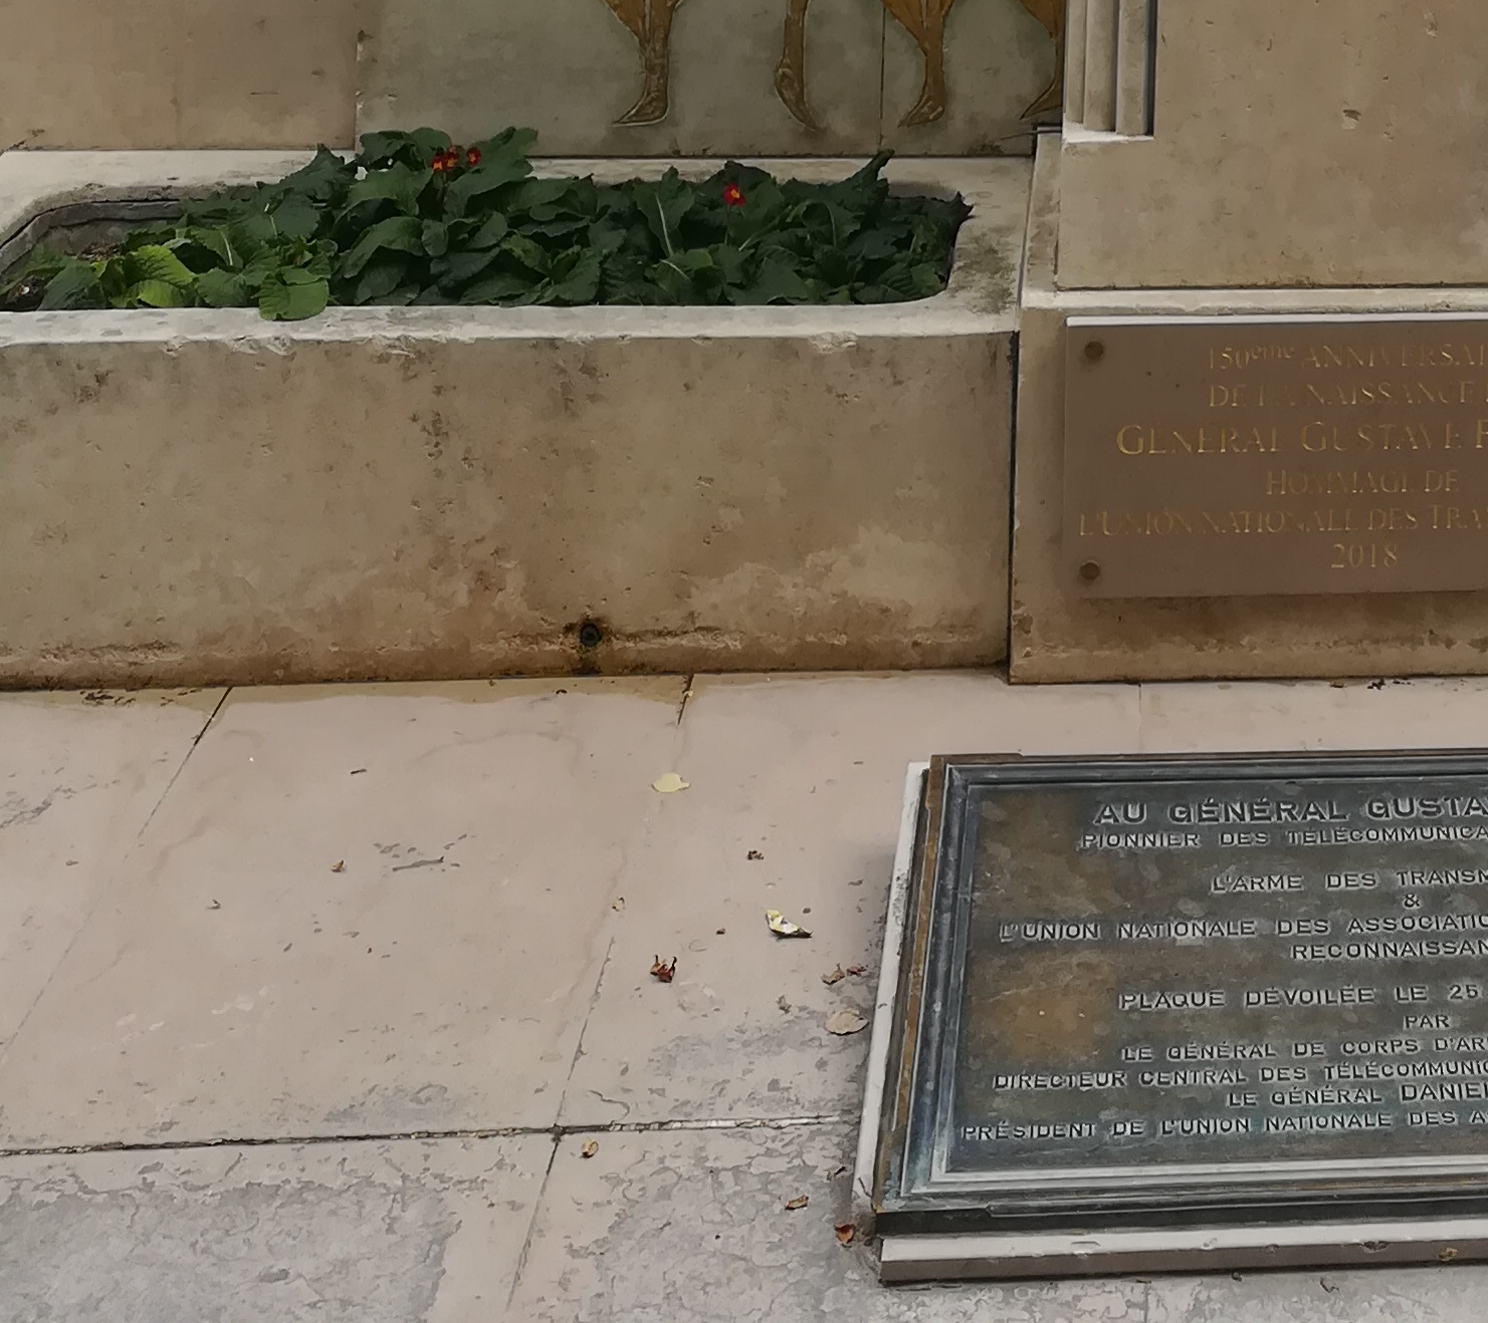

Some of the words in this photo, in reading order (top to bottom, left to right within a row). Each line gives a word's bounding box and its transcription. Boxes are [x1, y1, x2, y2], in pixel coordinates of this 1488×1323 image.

[1094, 802, 1148, 825] AU
[1167, 795, 1349, 825] GÉNÉRAL
[1079, 831, 1202, 852] PIONNIER
[1219, 830, 1271, 847] DES
[1210, 873, 1303, 894] L'ARME
[1325, 872, 1379, 890] DES
[1402, 892, 1422, 911] &
[1000, 922, 1099, 943] L'UNION
[1118, 919, 1258, 940] NATIONALE
[1276, 918, 1331, 937] DES
[1119, 991, 1228, 1011] PLAQUE
[1245, 985, 1377, 1008] DÉVOILÉE
[1394, 985, 1428, 1003] LE
[1448, 983, 1480, 1001] 25
[1403, 1013, 1451, 1030] PAR
[1121, 1046, 1154, 1061] LE
[1166, 1040, 1277, 1060] GÉNÉRAL
[1293, 1041, 1326, 1057] DE
[1342, 1037, 1420, 1055] CORPS
[992, 1070, 1127, 1090] DIRECTEUR
[1138, 1068, 1248, 1087] CENTRAL
[1260, 1066, 1306, 1082] DES
[1226, 1091, 1258, 1108] LE
[1270, 1086, 1383, 1107] GÉNÉRAL
[961, 1121, 1096, 1141] PRÉSIDENT
[1111, 1122, 1146, 1137] DE
[1161, 1116, 1251, 1135] L'UNION
[1264, 1112, 1392, 1132] NATIONALE
[1409, 1111, 1457, 1127] DES
